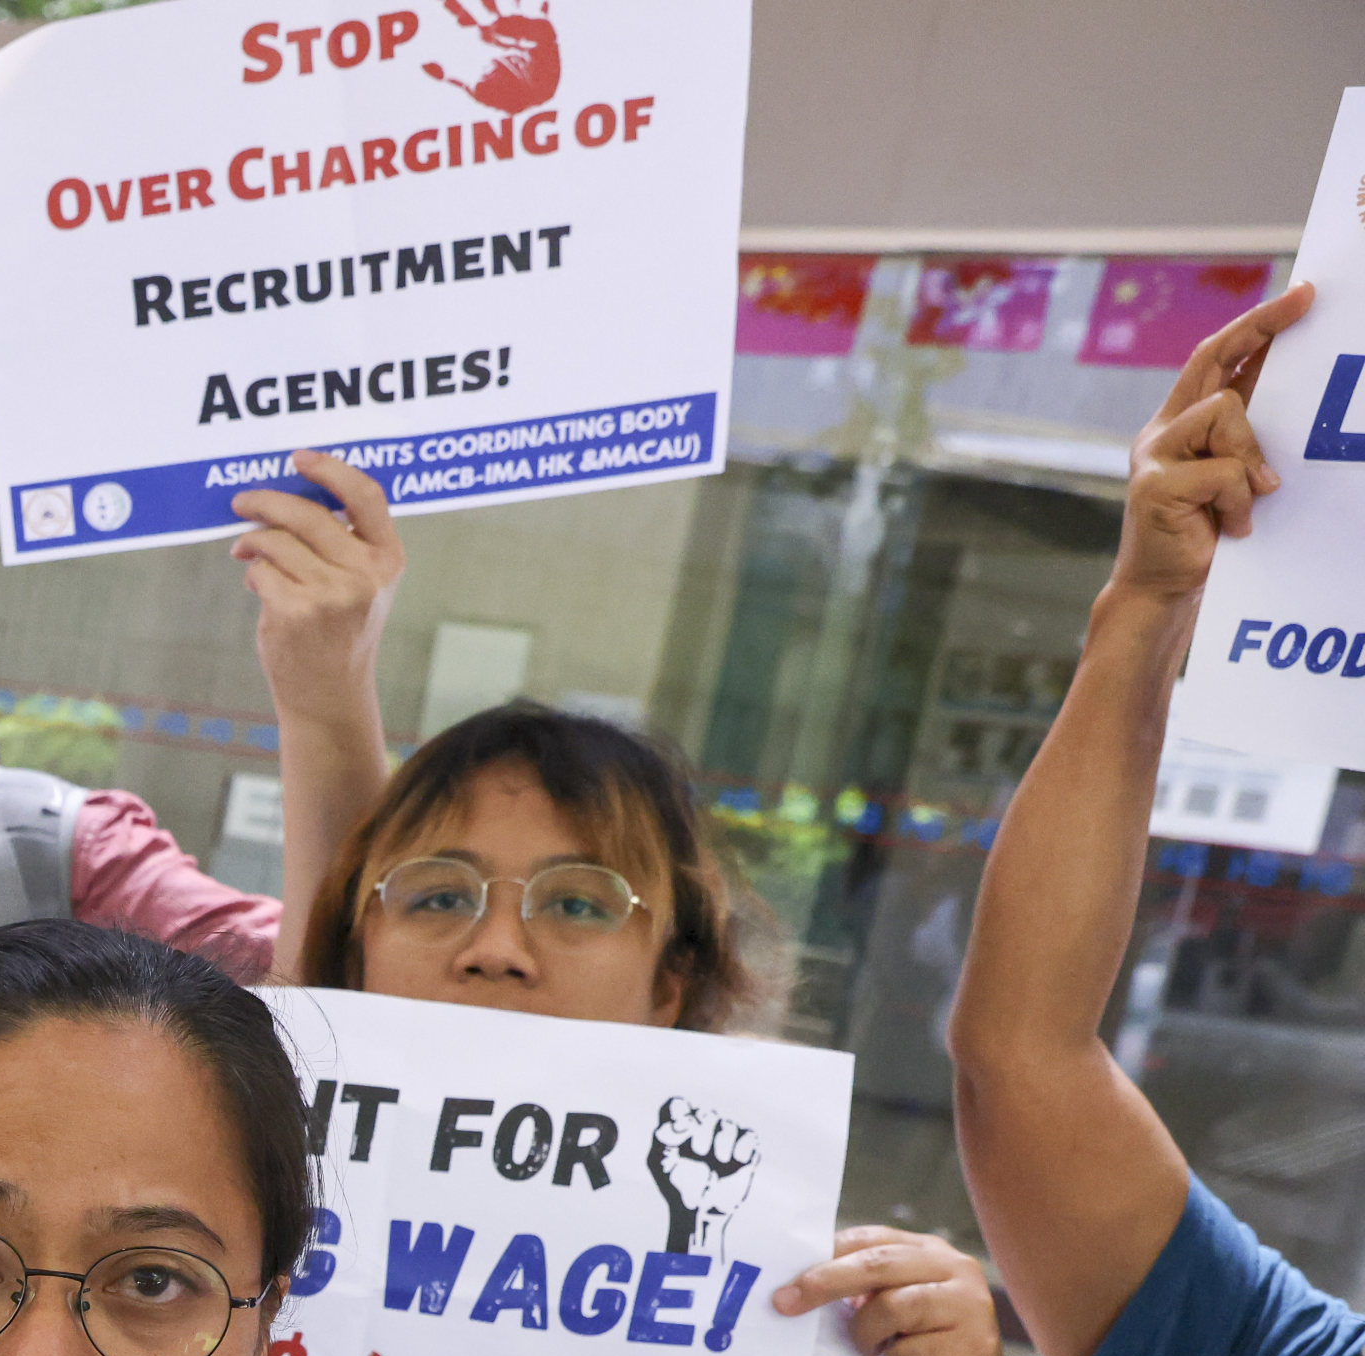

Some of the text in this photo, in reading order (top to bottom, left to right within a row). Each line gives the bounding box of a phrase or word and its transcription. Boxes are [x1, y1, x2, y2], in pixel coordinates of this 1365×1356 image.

[242, 9, 419, 84] STOP
[46, 96, 655, 230] OVER CHARGING OF
[131, 226, 572, 327] RECRUITMENT
[197, 347, 511, 426] AGENCIES!
[205, 458, 279, 490] ASIAN
[418, 417, 616, 465] COORDINATING
[620, 402, 691, 435] BODY
[392, 433, 701, 502] (AMCB-IMA HK &MACAU)
[430, 1097, 621, 1191] FOR
[383, 1219, 763, 1353] WAGE!
